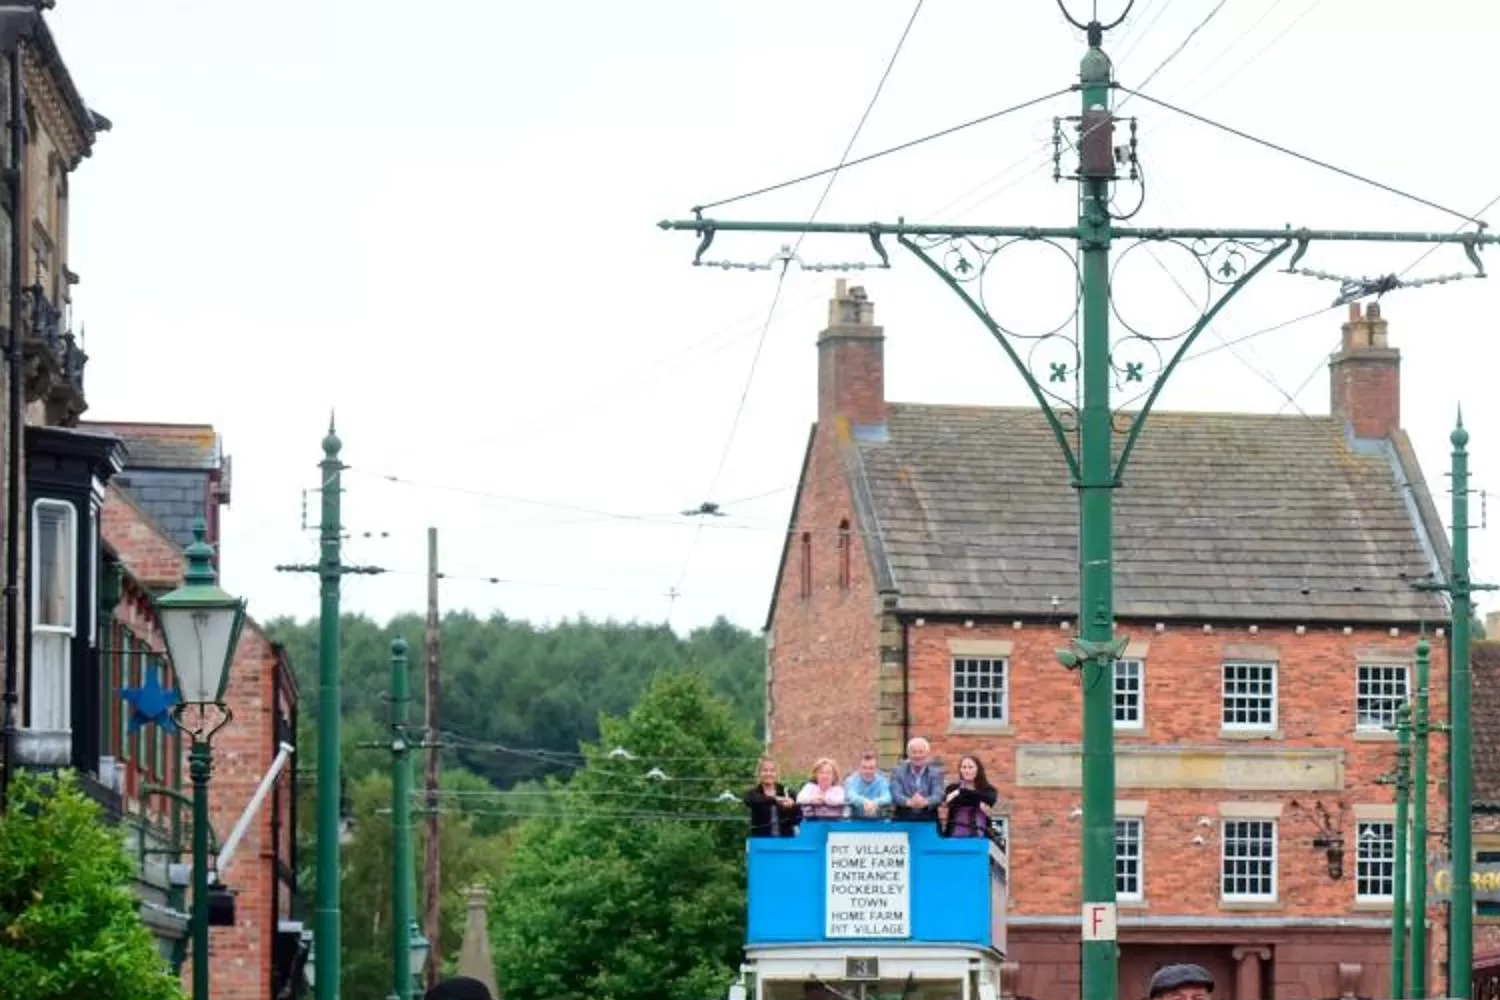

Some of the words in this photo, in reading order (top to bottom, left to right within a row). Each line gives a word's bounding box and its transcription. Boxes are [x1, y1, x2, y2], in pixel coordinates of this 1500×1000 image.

[831, 845, 849, 854] PIT
[855, 845, 905, 855] VILLAGE
[831, 859, 867, 868] HOME
[871, 859, 905, 868] FARM
[834, 872, 900, 881] ENTRANCE
[831, 884, 904, 894] POCKERLEY
[850, 898, 888, 907] TOWN
[831, 911, 865, 920] HOME
[869, 911, 903, 920] FARM
[1092, 906, 1107, 938] F
[831, 924, 848, 934] PIT
[853, 924, 904, 934] VILLAGE
